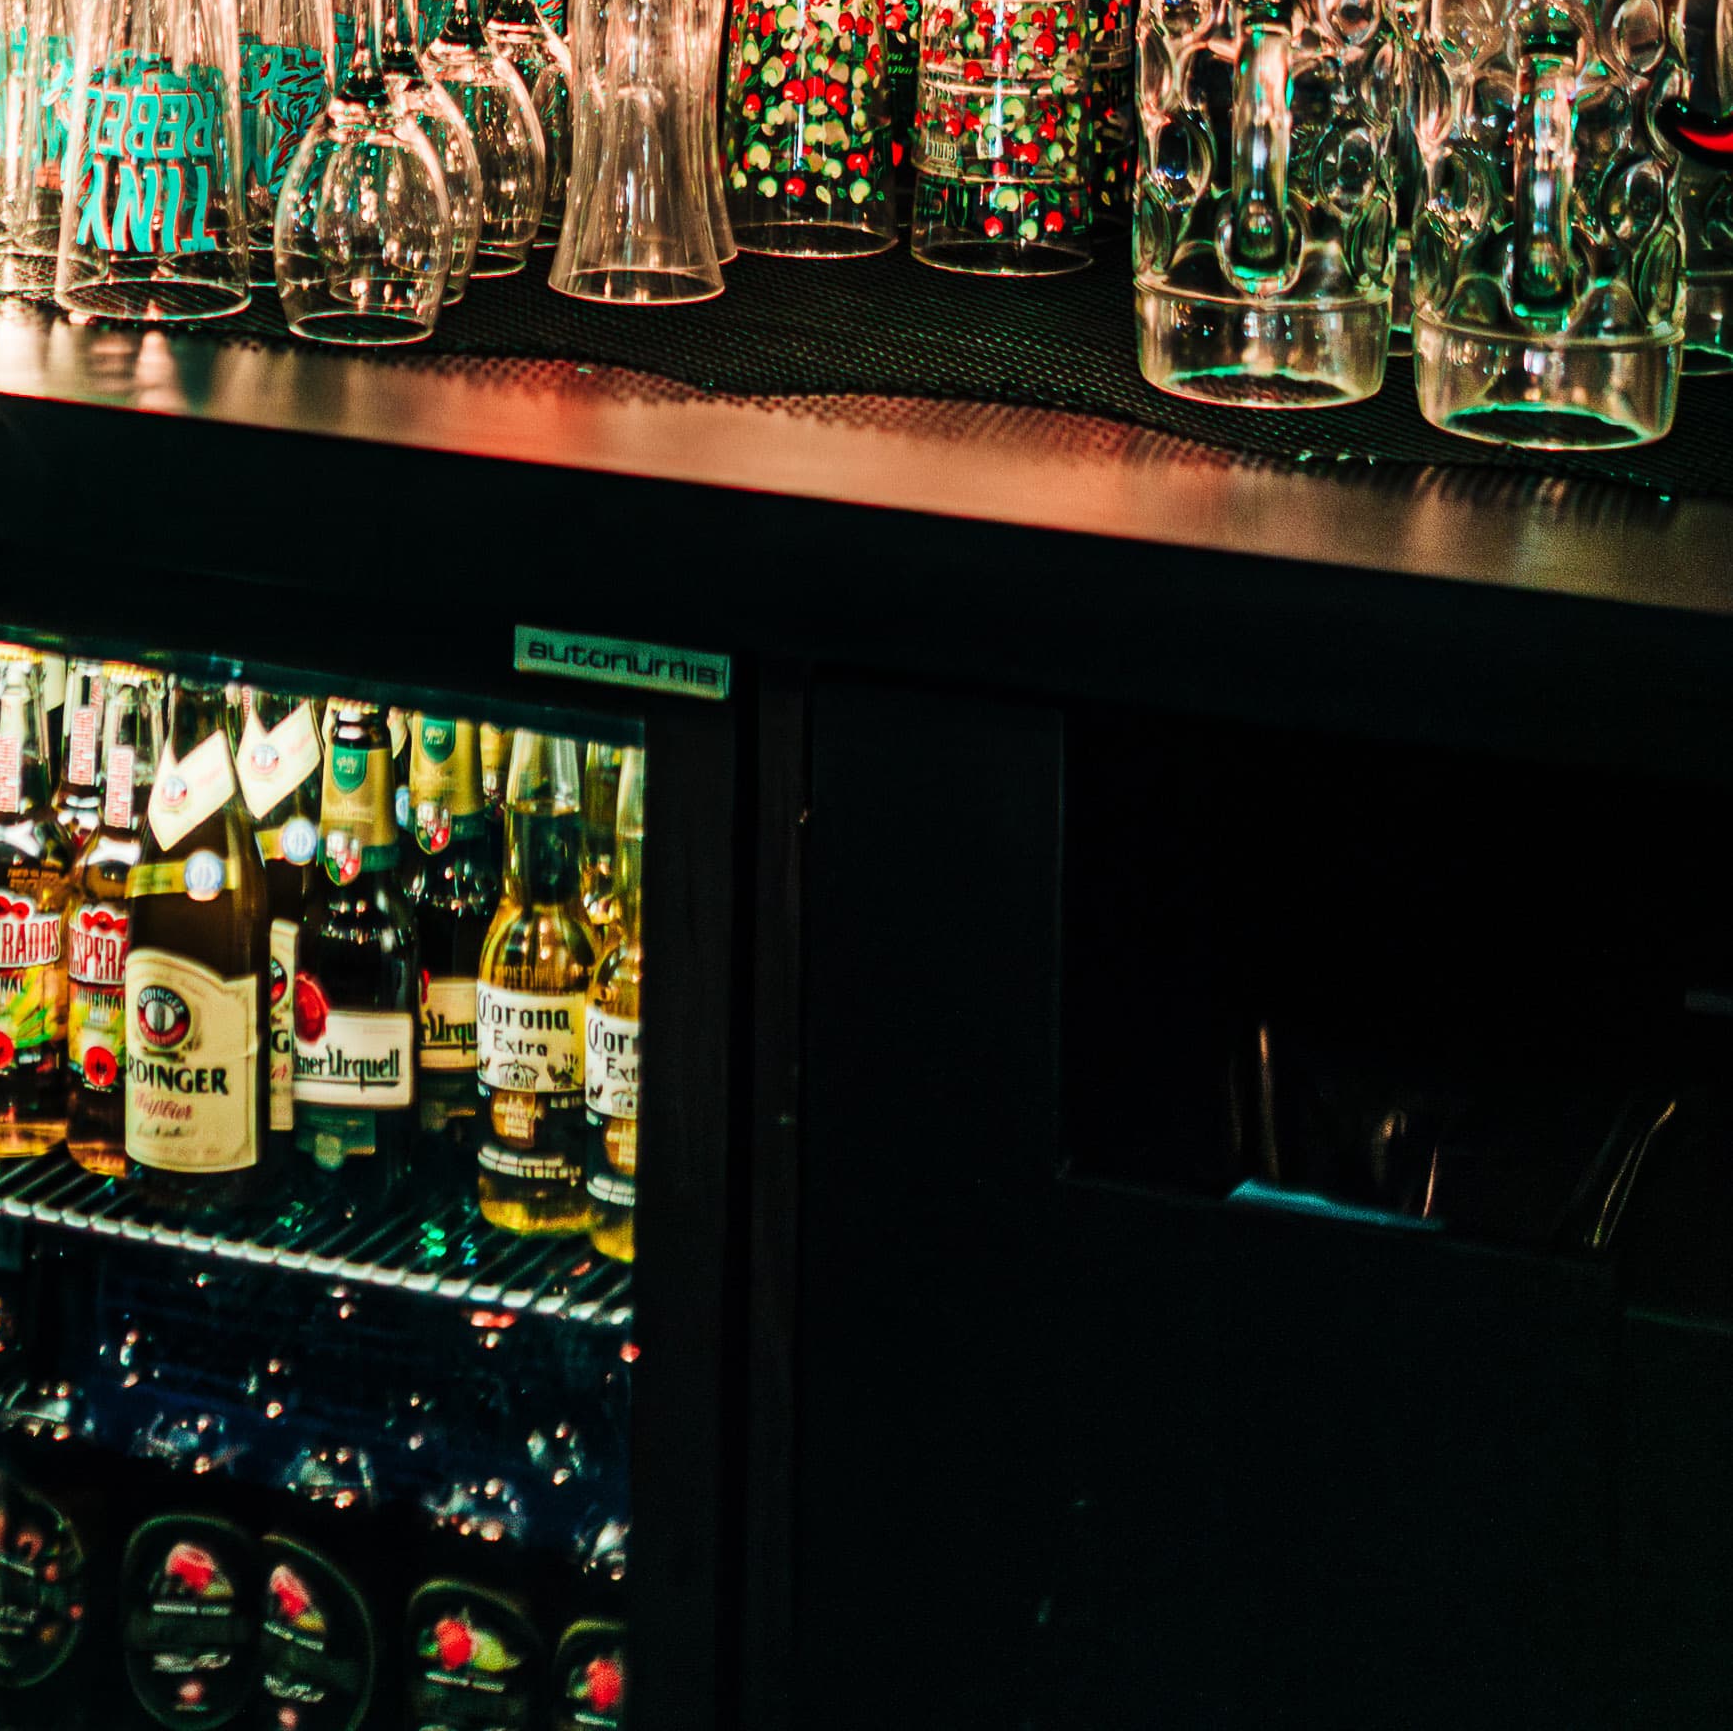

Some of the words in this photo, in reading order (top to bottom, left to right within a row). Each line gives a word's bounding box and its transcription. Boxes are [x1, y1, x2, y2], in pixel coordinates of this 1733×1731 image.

[81, 89, 214, 158] REBEL
[76, 159, 216, 252] TINY
[527, 639, 720, 686] autonumis
[478, 991, 570, 1032] Corona
[493, 1030, 548, 1057] Extra
[128, 1058, 229, 1096] RDINGER
